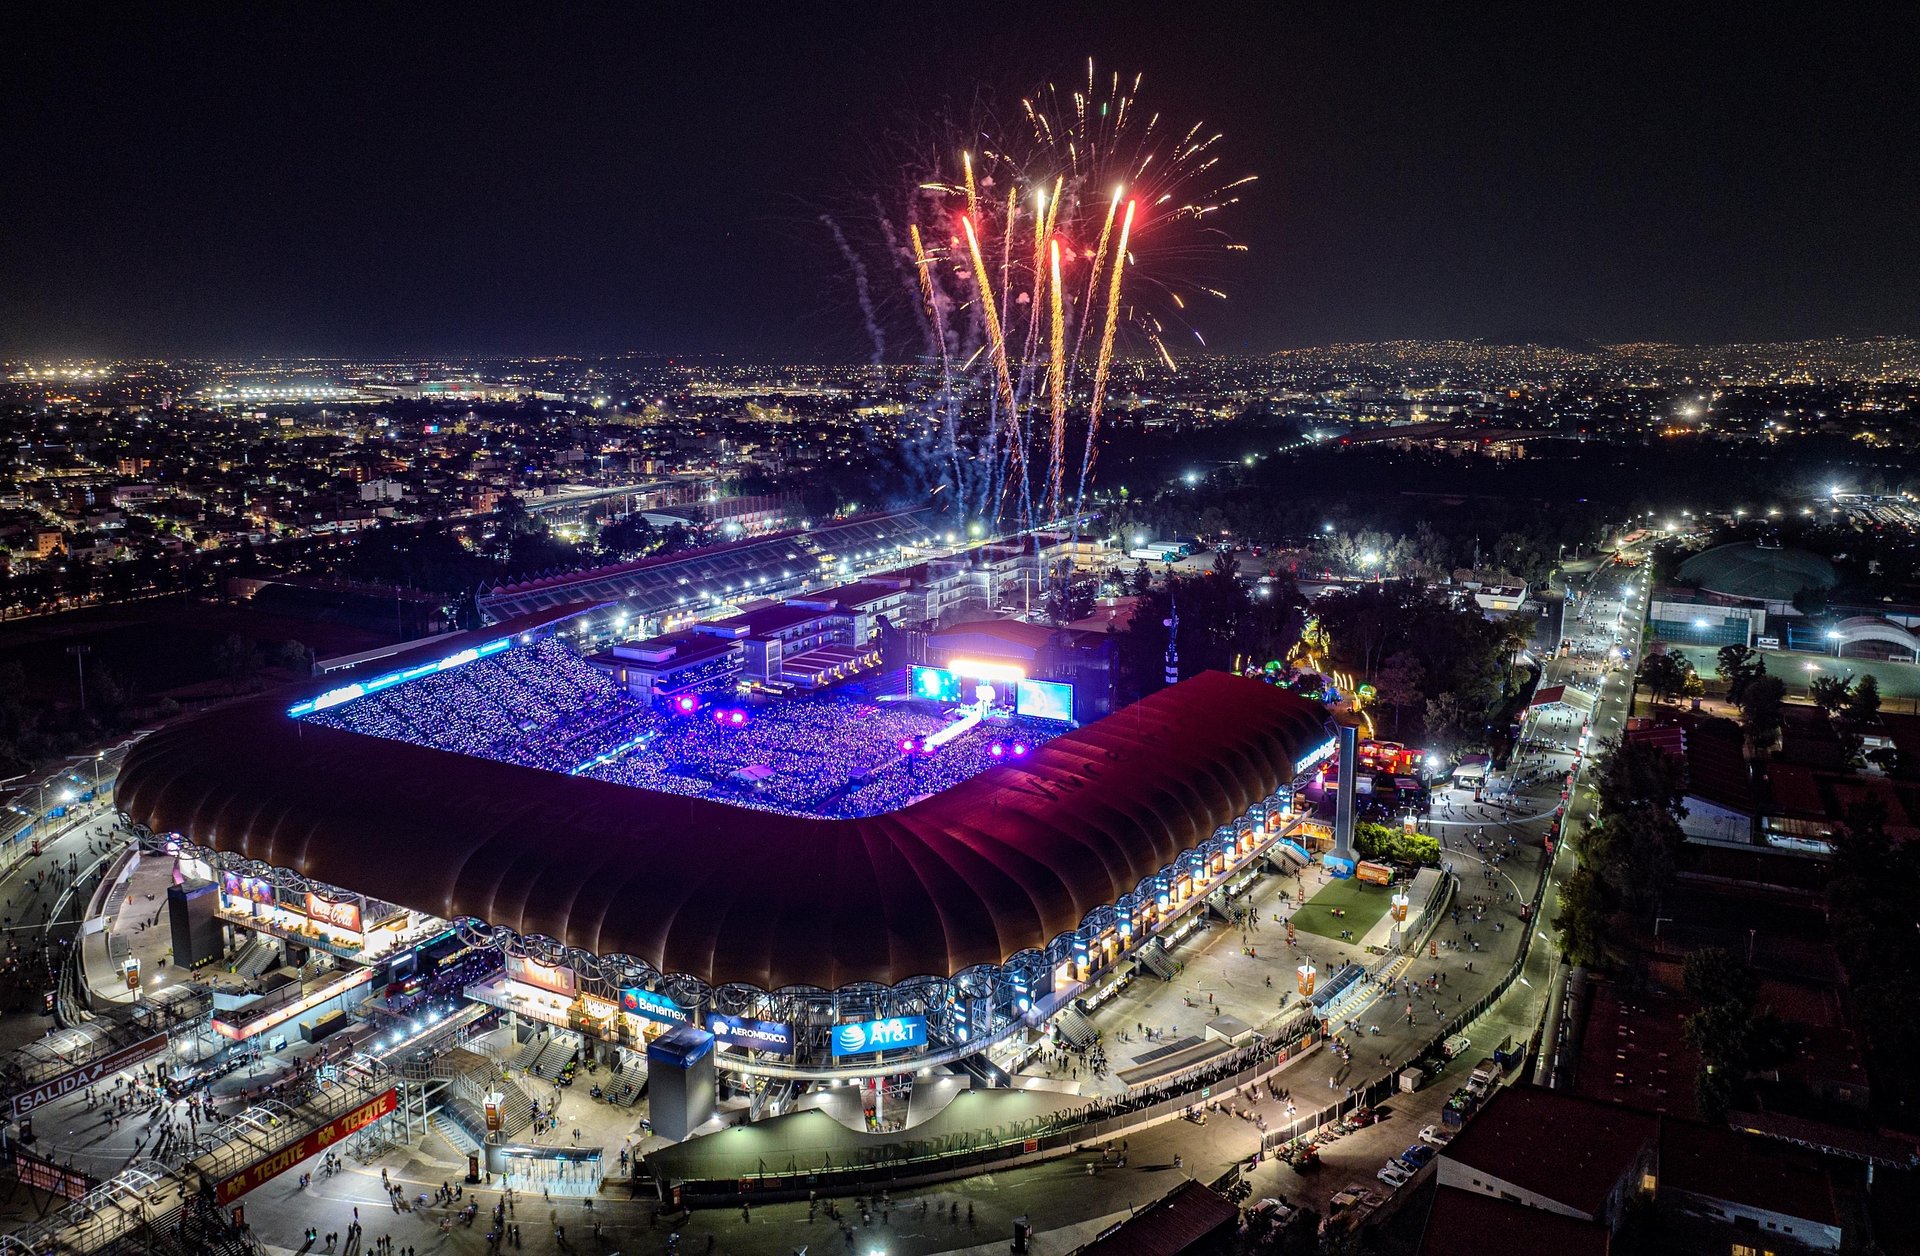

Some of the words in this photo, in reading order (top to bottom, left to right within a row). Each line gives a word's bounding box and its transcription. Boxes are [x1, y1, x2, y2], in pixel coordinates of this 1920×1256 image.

[311, 898, 353, 927] Coca-Cola
[639, 997, 687, 1022] Banamex
[869, 1022, 917, 1045] AT&T
[20, 1071, 89, 1111] SALIDA
[341, 1095, 387, 1133] TECATE
[488, 1115, 497, 1126] E
[253, 1141, 305, 1182] TECATE
